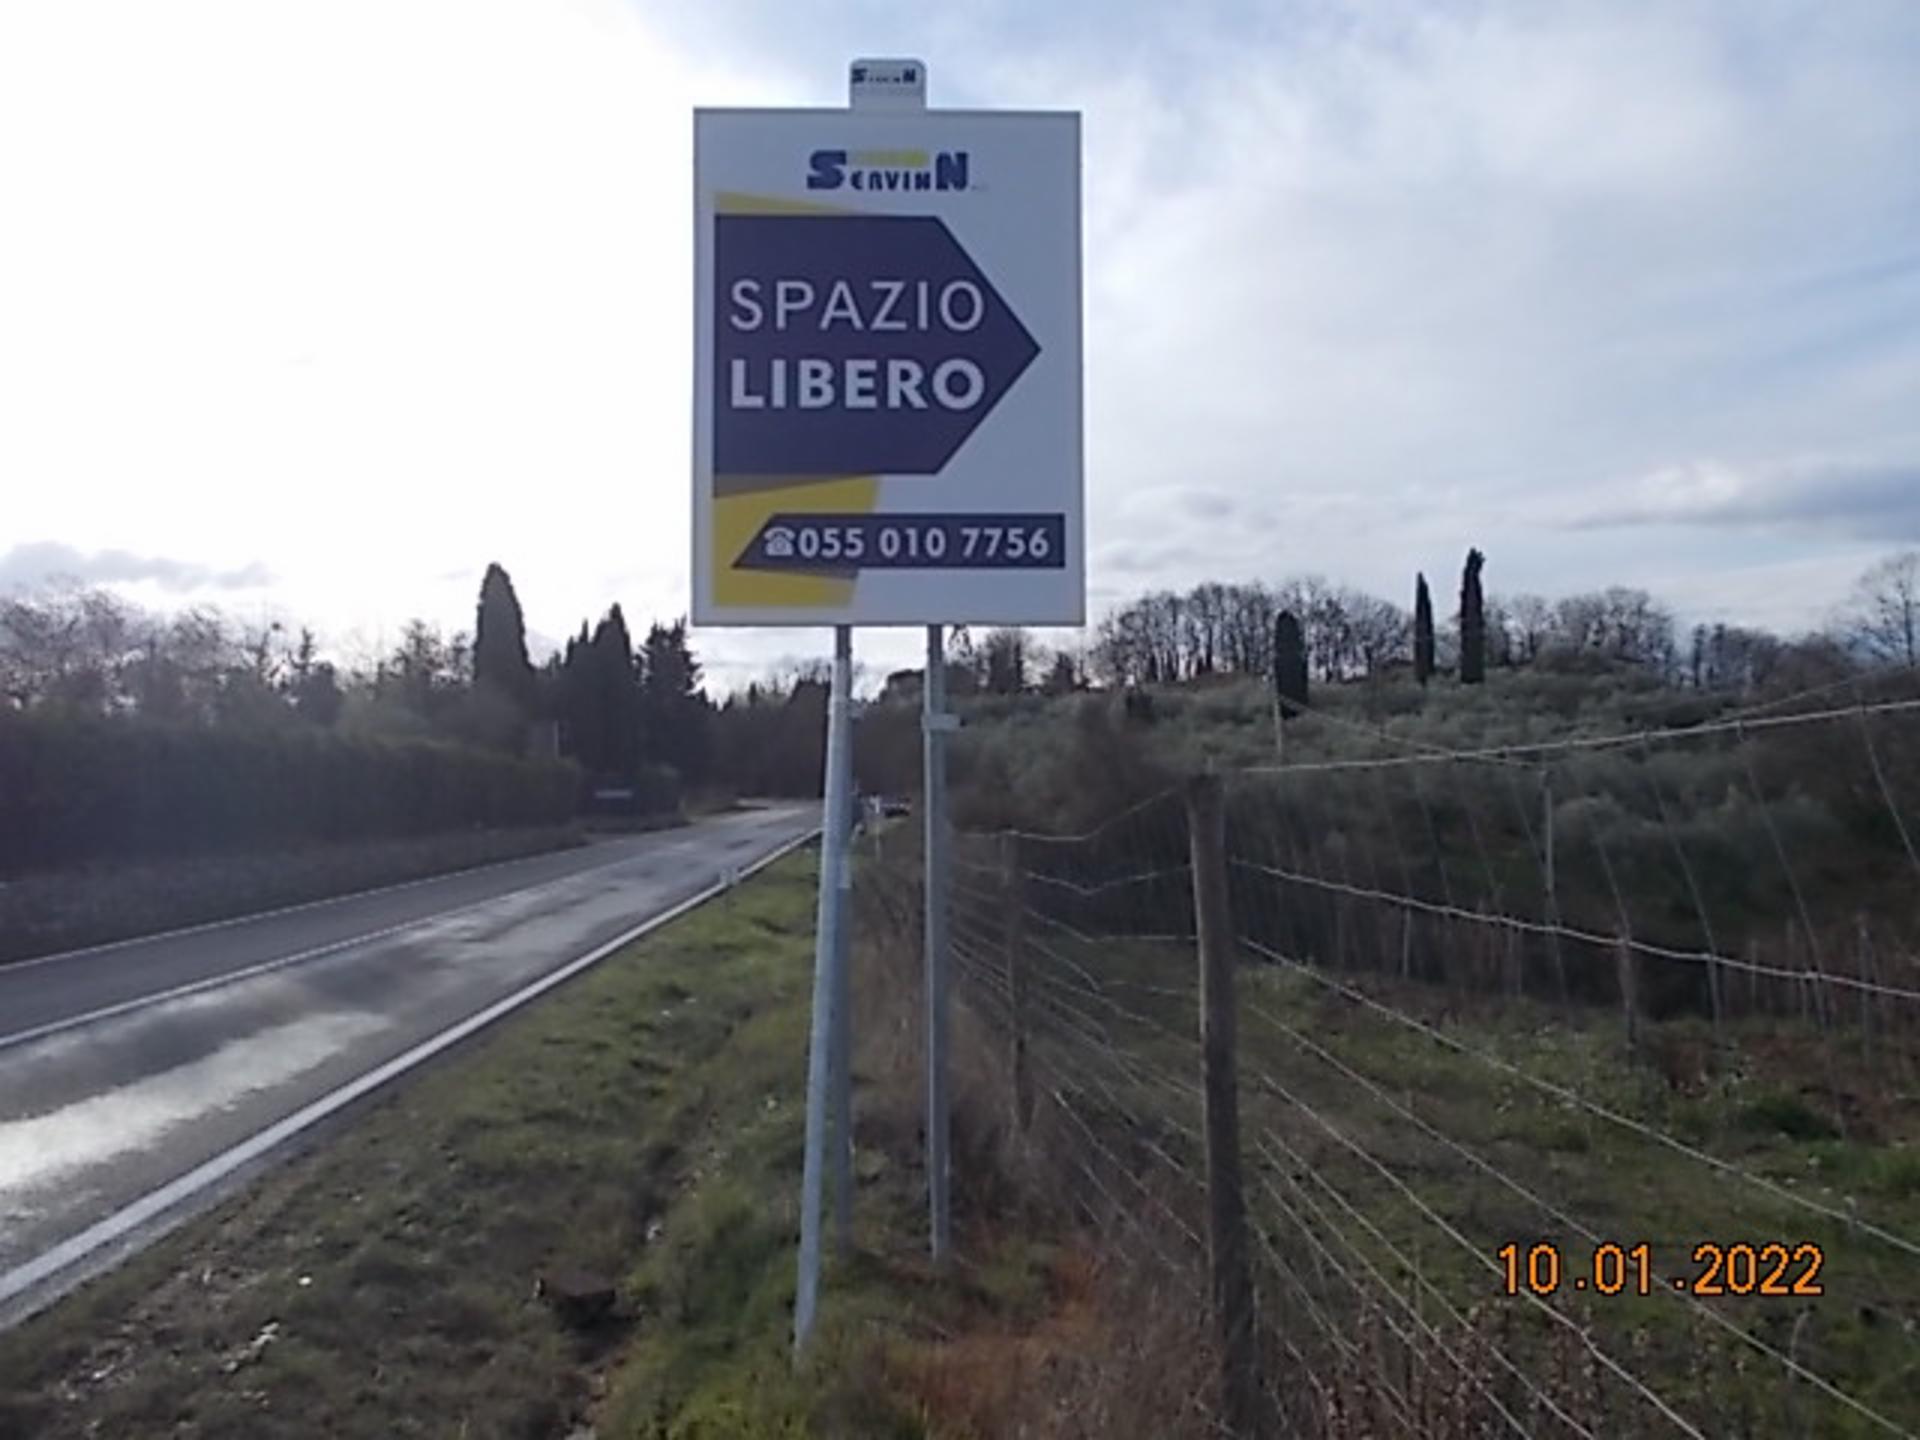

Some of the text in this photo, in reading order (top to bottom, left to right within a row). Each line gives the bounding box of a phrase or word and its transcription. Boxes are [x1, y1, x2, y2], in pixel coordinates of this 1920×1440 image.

[730, 279, 985, 331] SPAZIO
[730, 359, 986, 411] LIBERO
[799, 527, 1049, 558] 055 010 7756
